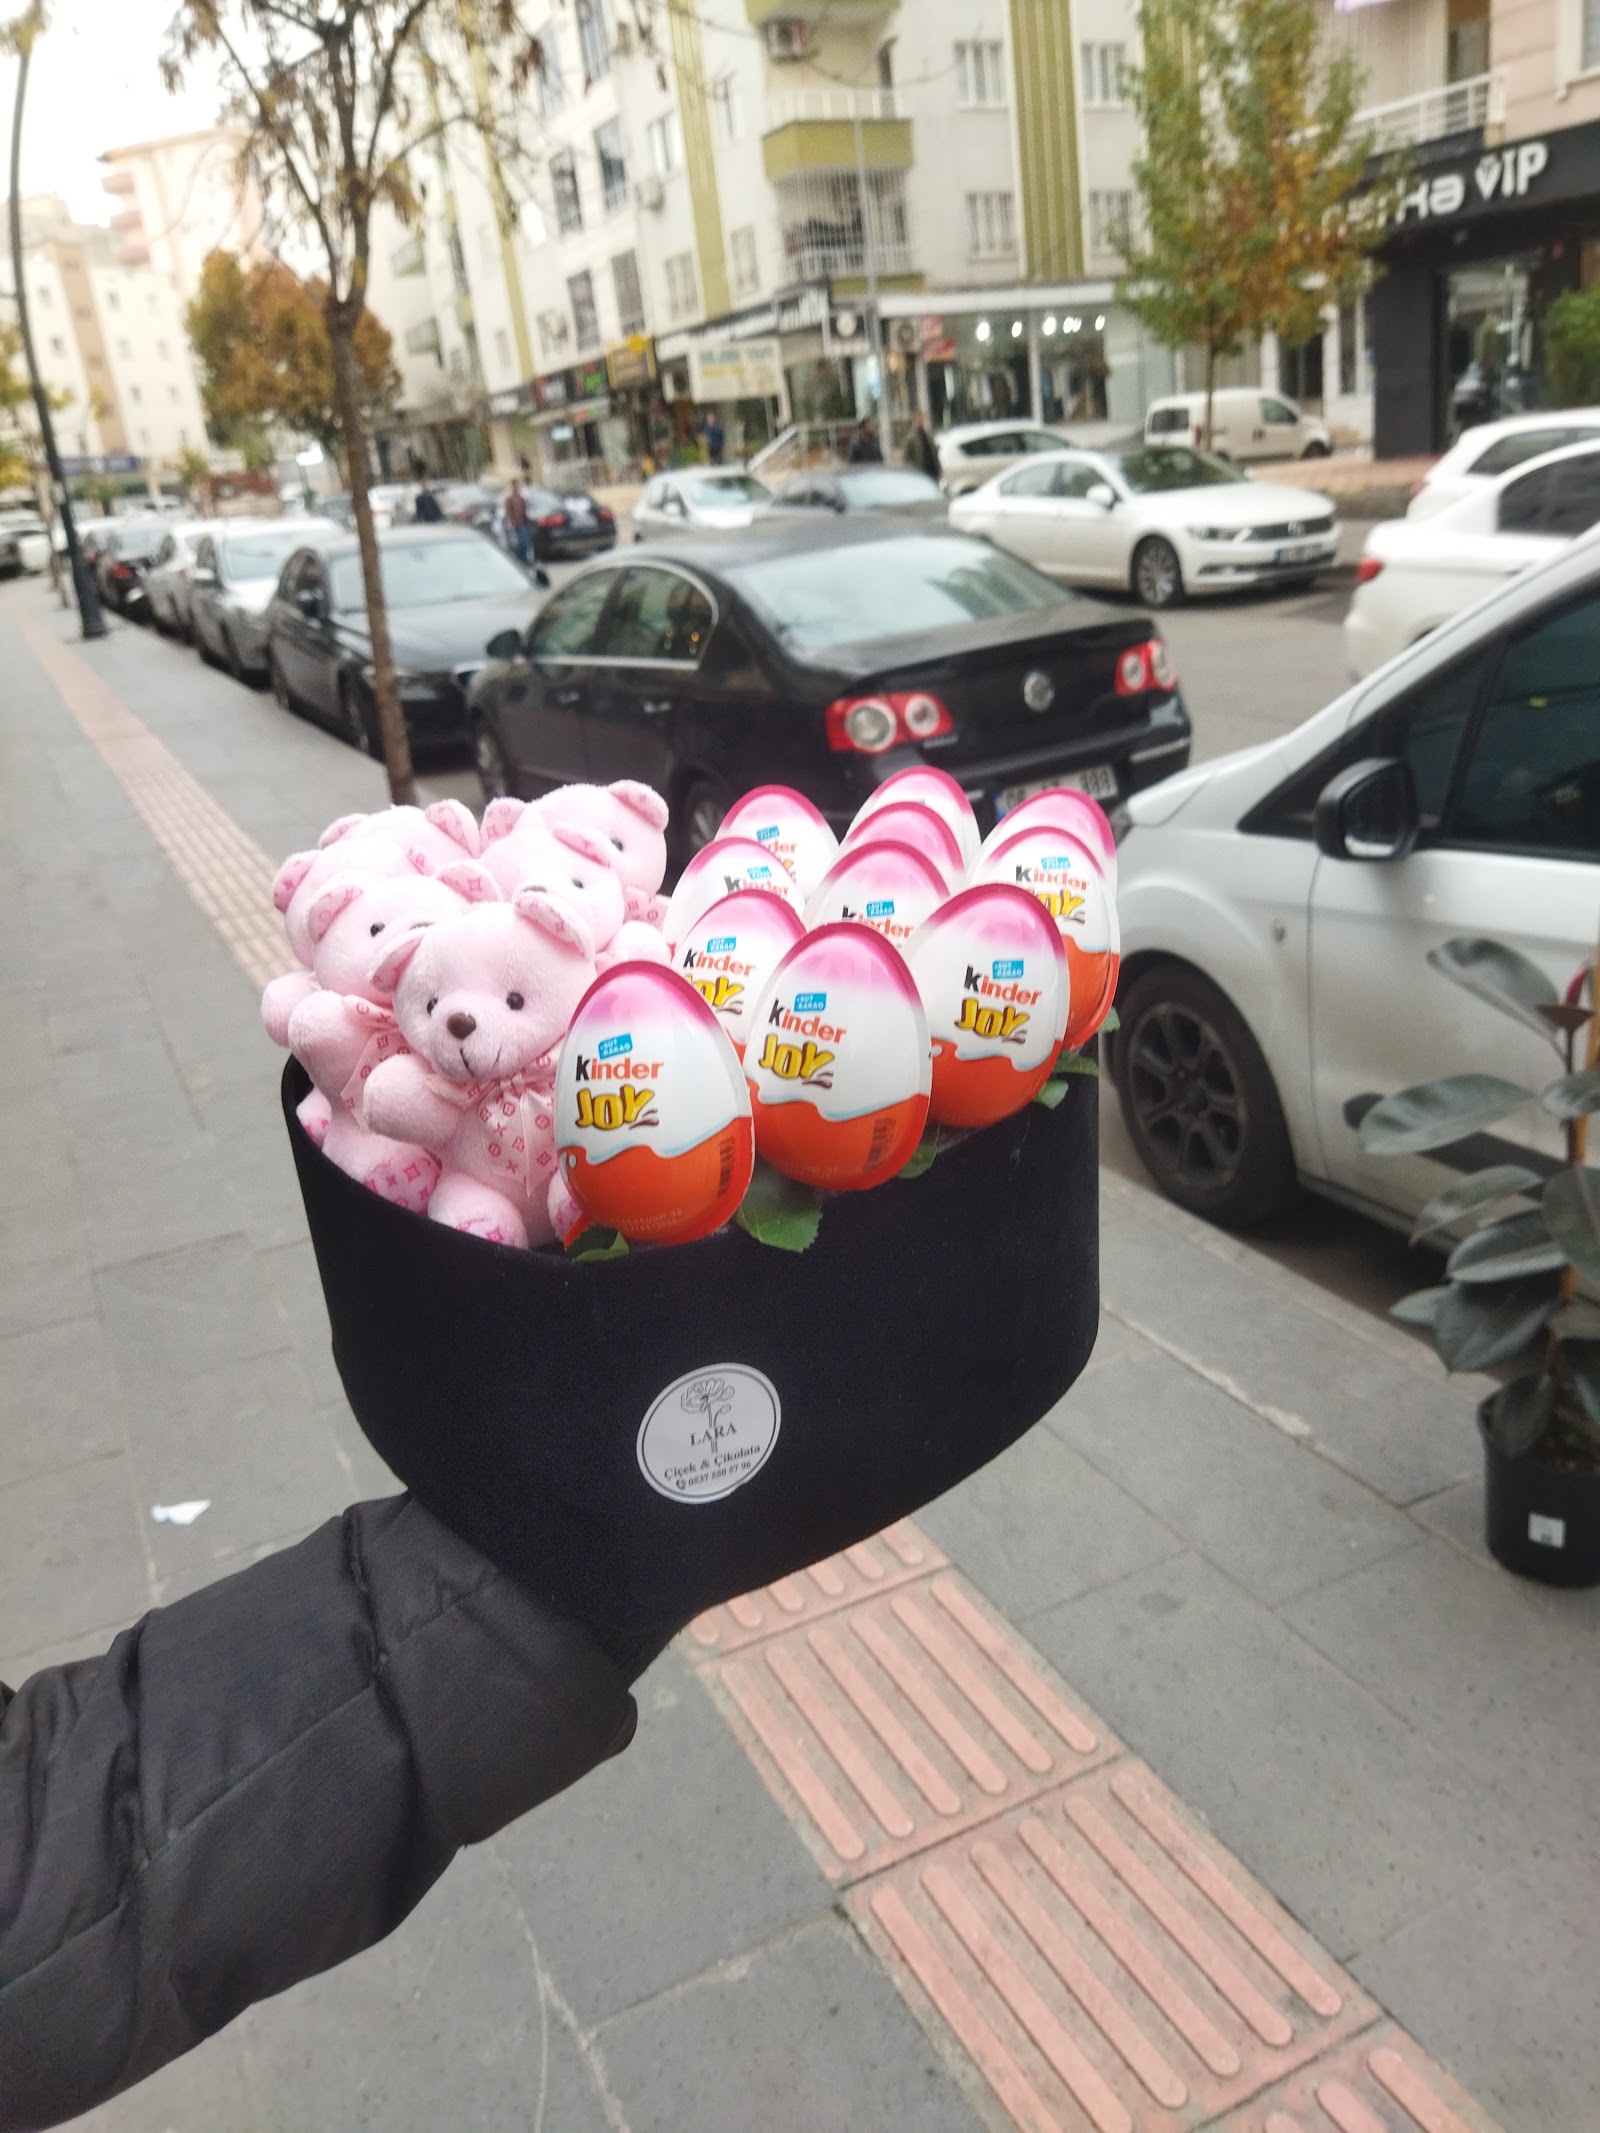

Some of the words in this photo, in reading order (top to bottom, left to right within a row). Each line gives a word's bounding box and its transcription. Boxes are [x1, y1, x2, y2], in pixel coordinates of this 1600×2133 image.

[1474, 141, 1548, 200] VIP
[1027, 888, 1085, 918] OY
[683, 947, 756, 977] kinder
[685, 974, 744, 1007] OY
[963, 964, 1042, 1006] kinder
[768, 996, 847, 1043] kinder
[954, 997, 1030, 1039] JOY
[576, 1054, 664, 1082] kinder
[758, 1034, 835, 1079] JOY
[575, 1084, 655, 1131] JOY
[690, 1422, 737, 1447] LARA
[714, 1444, 760, 1467] Çikolata
